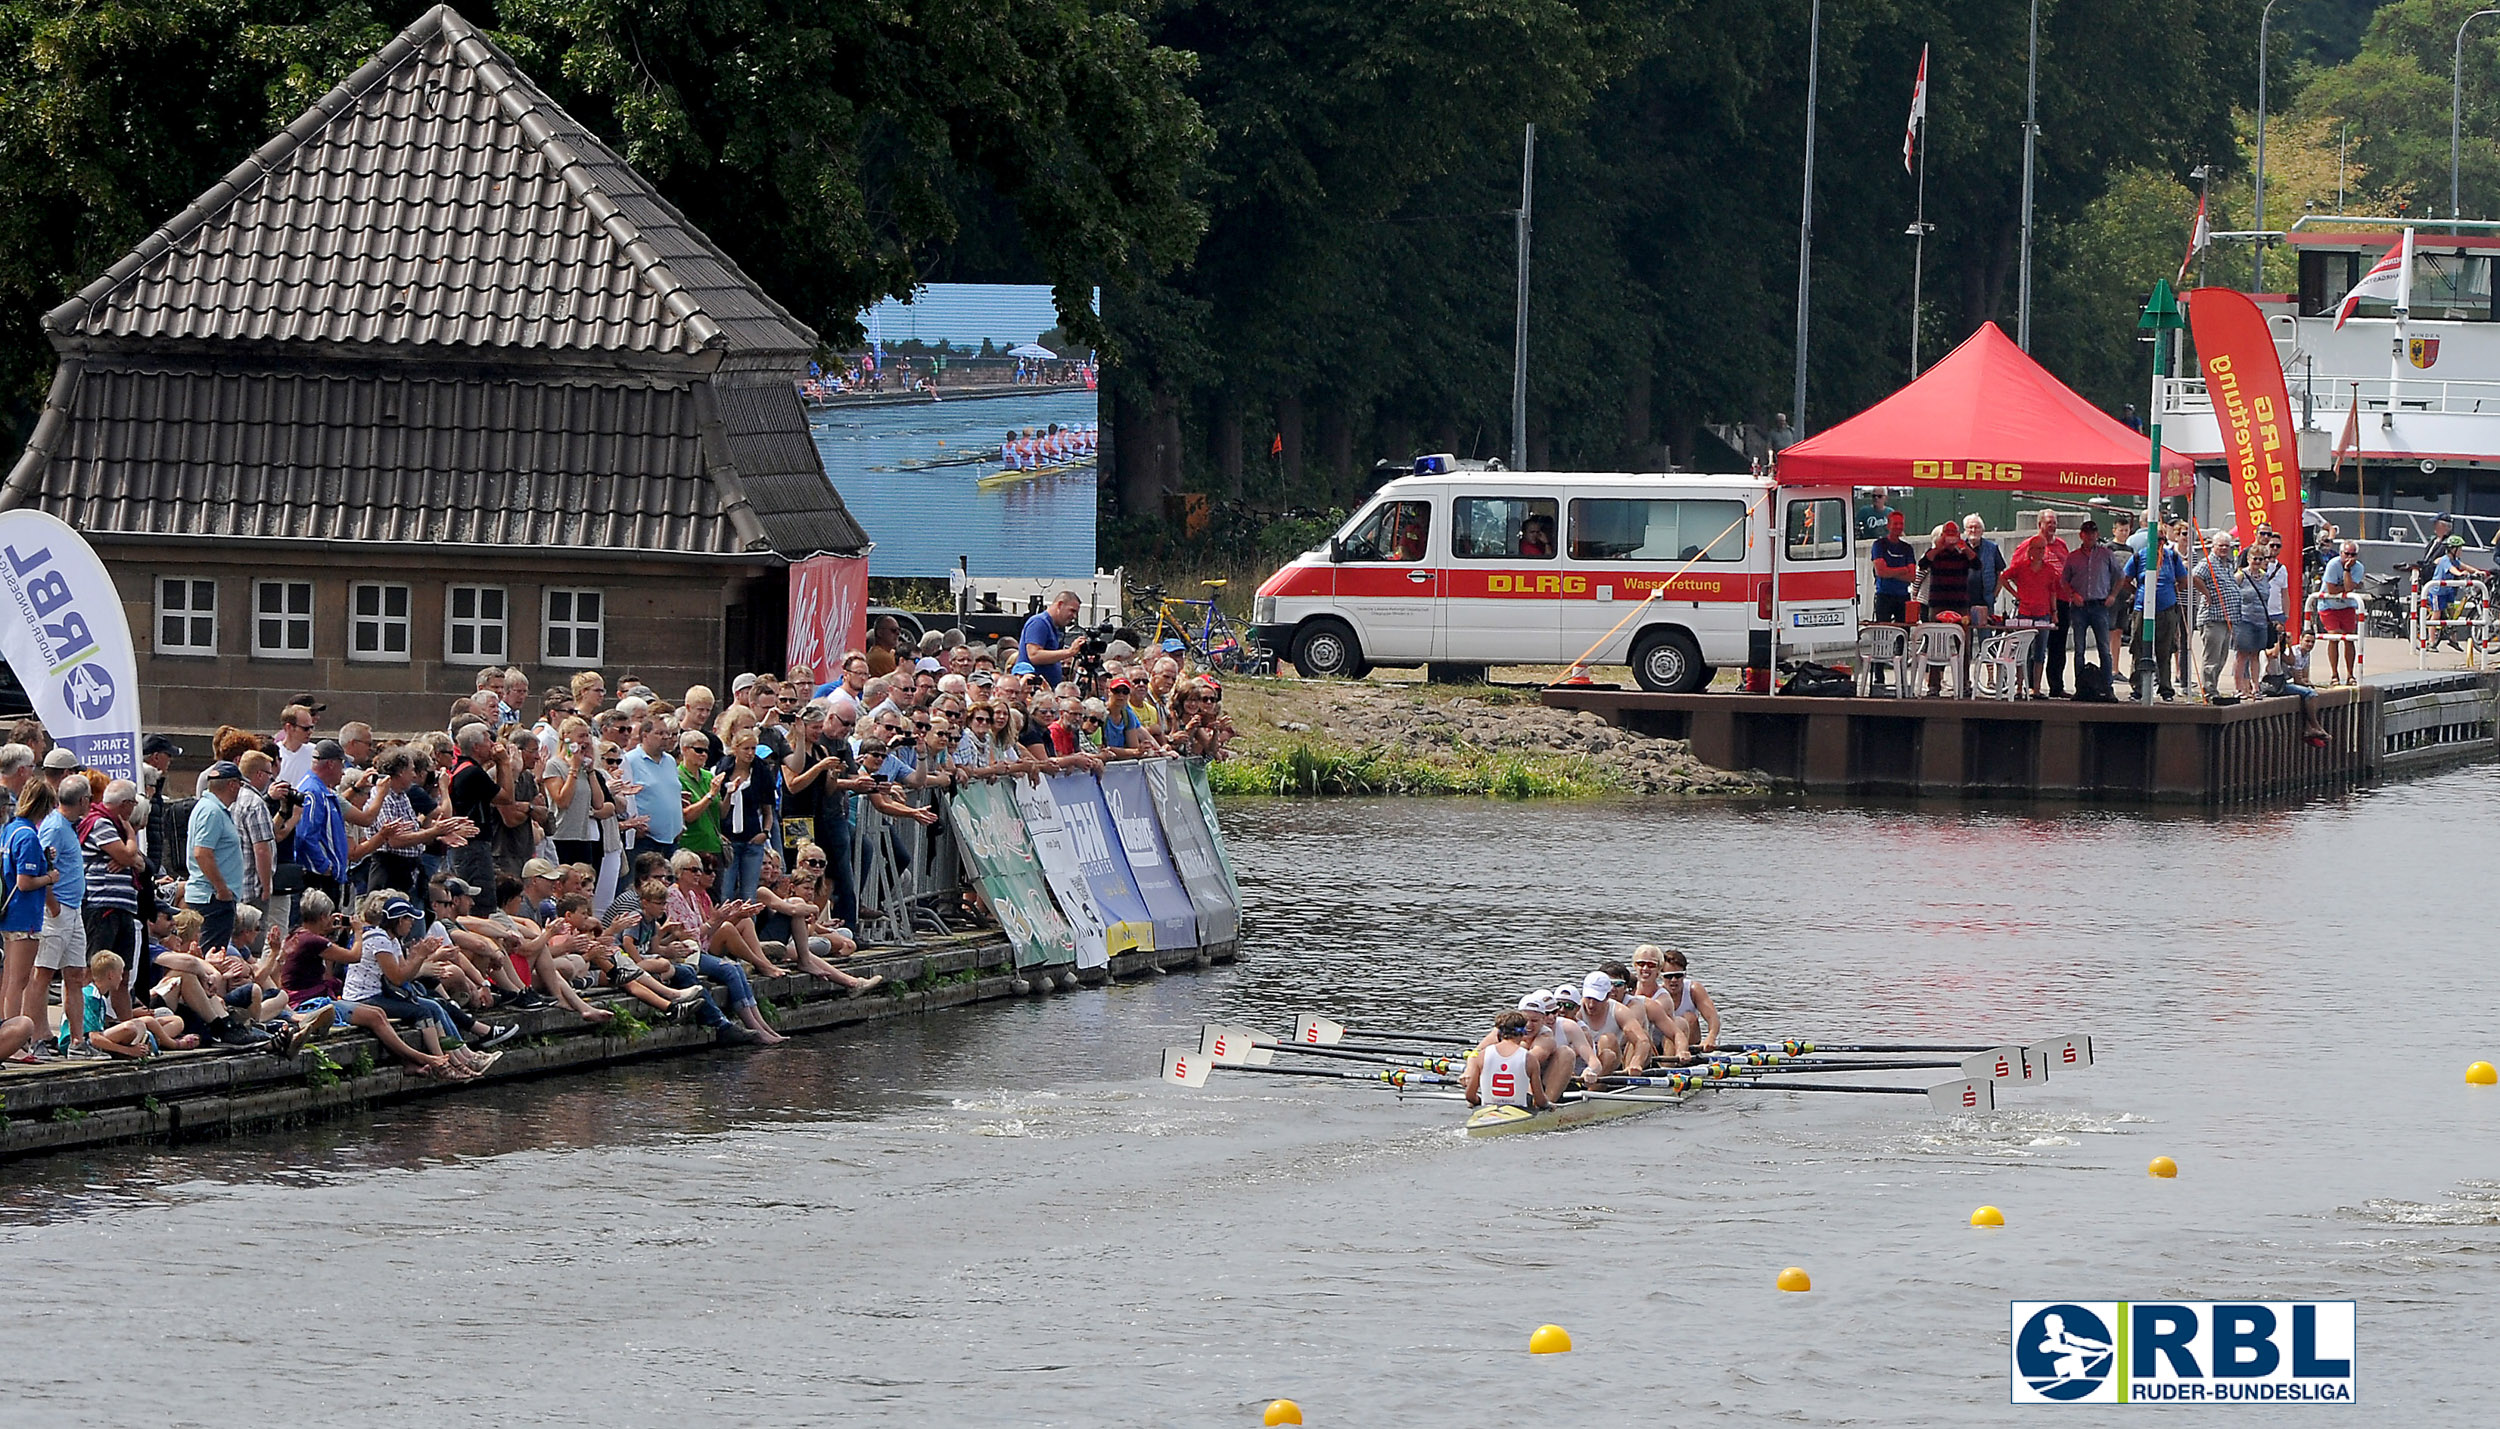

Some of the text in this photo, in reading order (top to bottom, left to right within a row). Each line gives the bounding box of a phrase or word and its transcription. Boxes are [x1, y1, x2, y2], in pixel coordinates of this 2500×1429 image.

[1913, 460, 2023, 482] DLRG
[2059, 470, 2117, 487] Minden
[1488, 575, 1587, 593] DLRG
[1818, 614, 1840, 623] 2012
